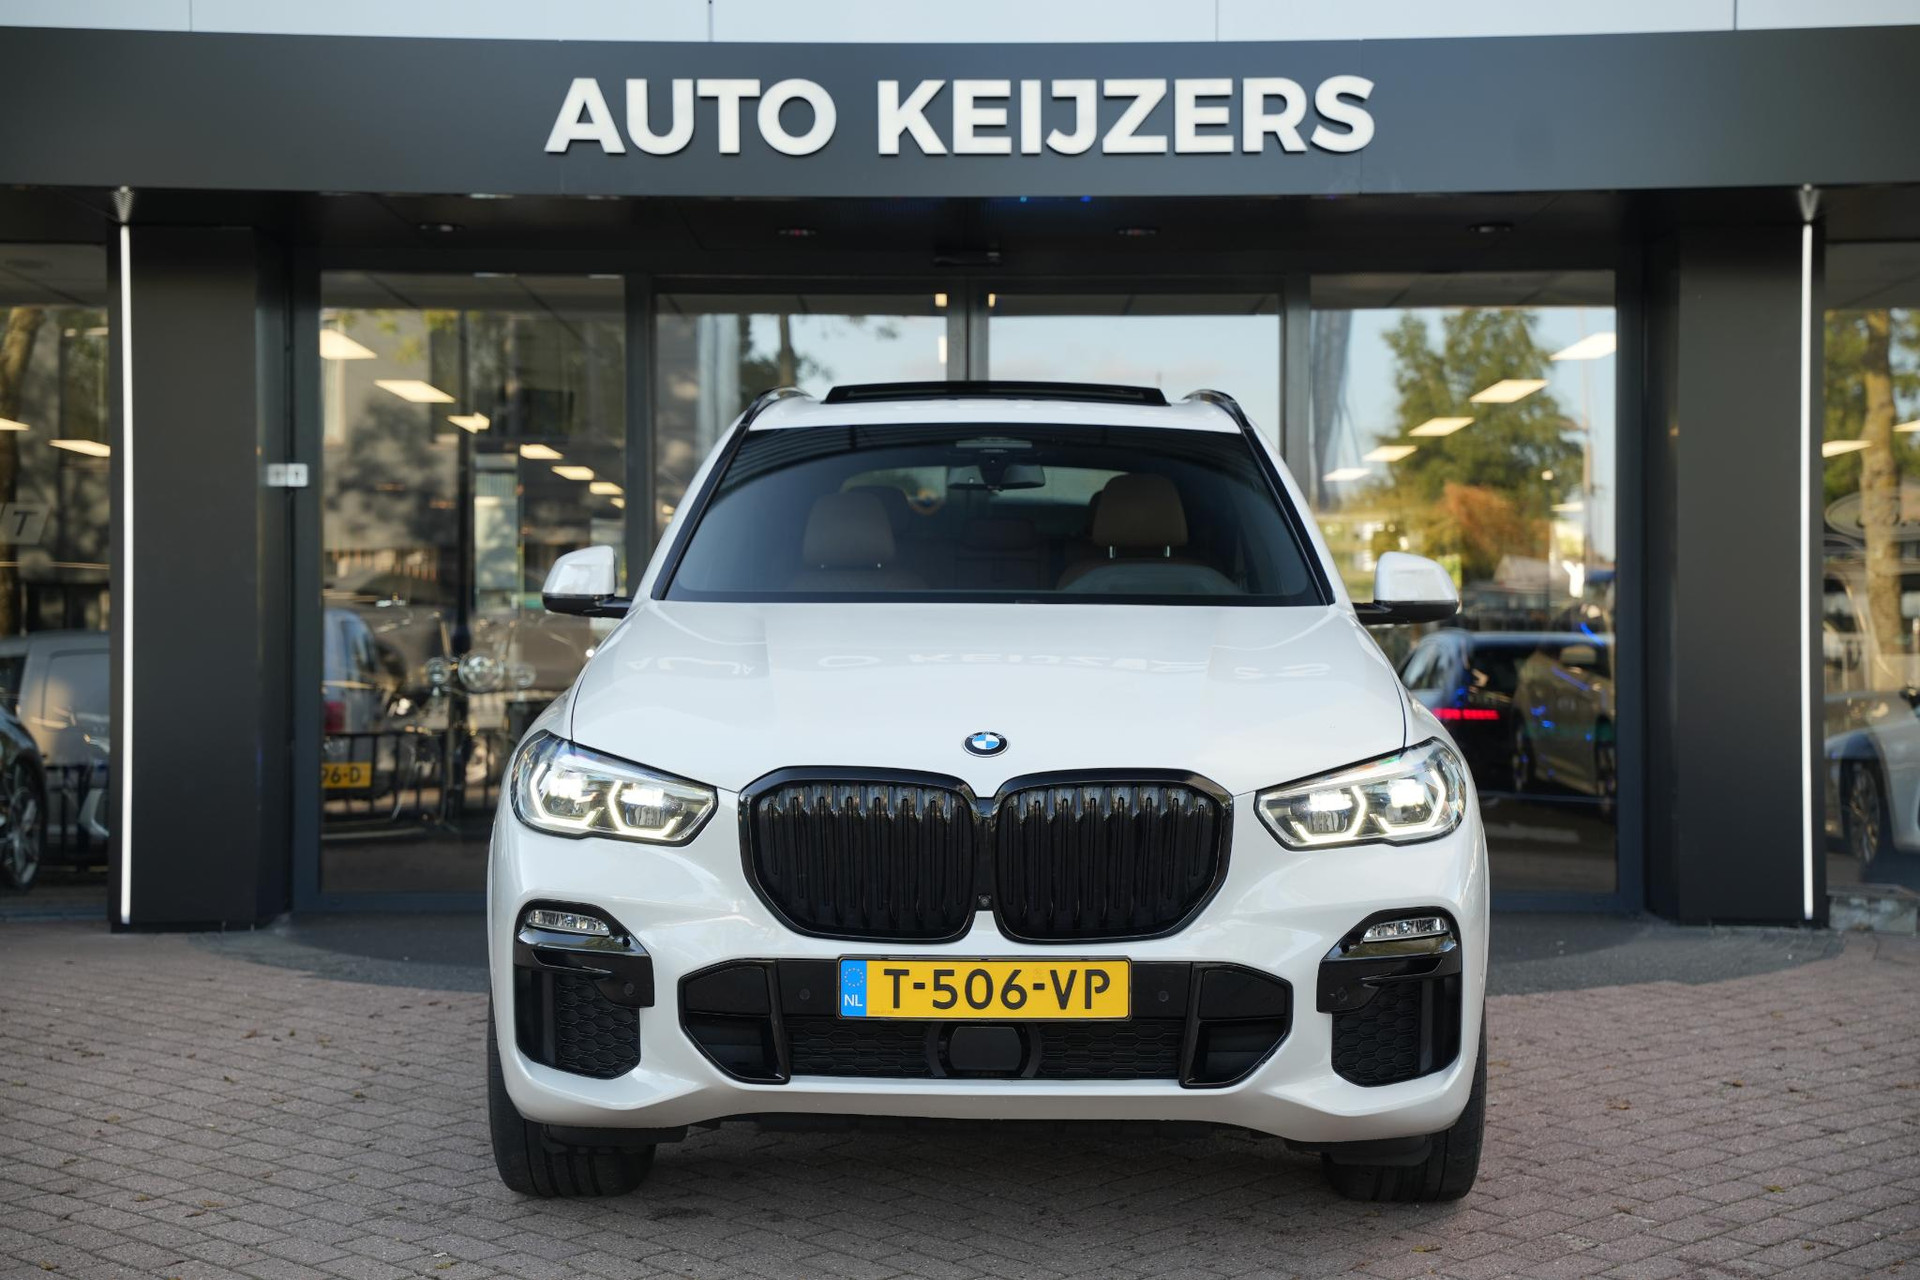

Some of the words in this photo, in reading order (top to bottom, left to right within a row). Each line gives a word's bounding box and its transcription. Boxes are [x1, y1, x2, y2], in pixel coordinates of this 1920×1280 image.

[544, 77, 838, 156] AUTO
[877, 74, 1376, 155] KEIJZERS
[844, 994, 863, 1007] NL
[883, 968, 1111, 1010] T-506-VP
